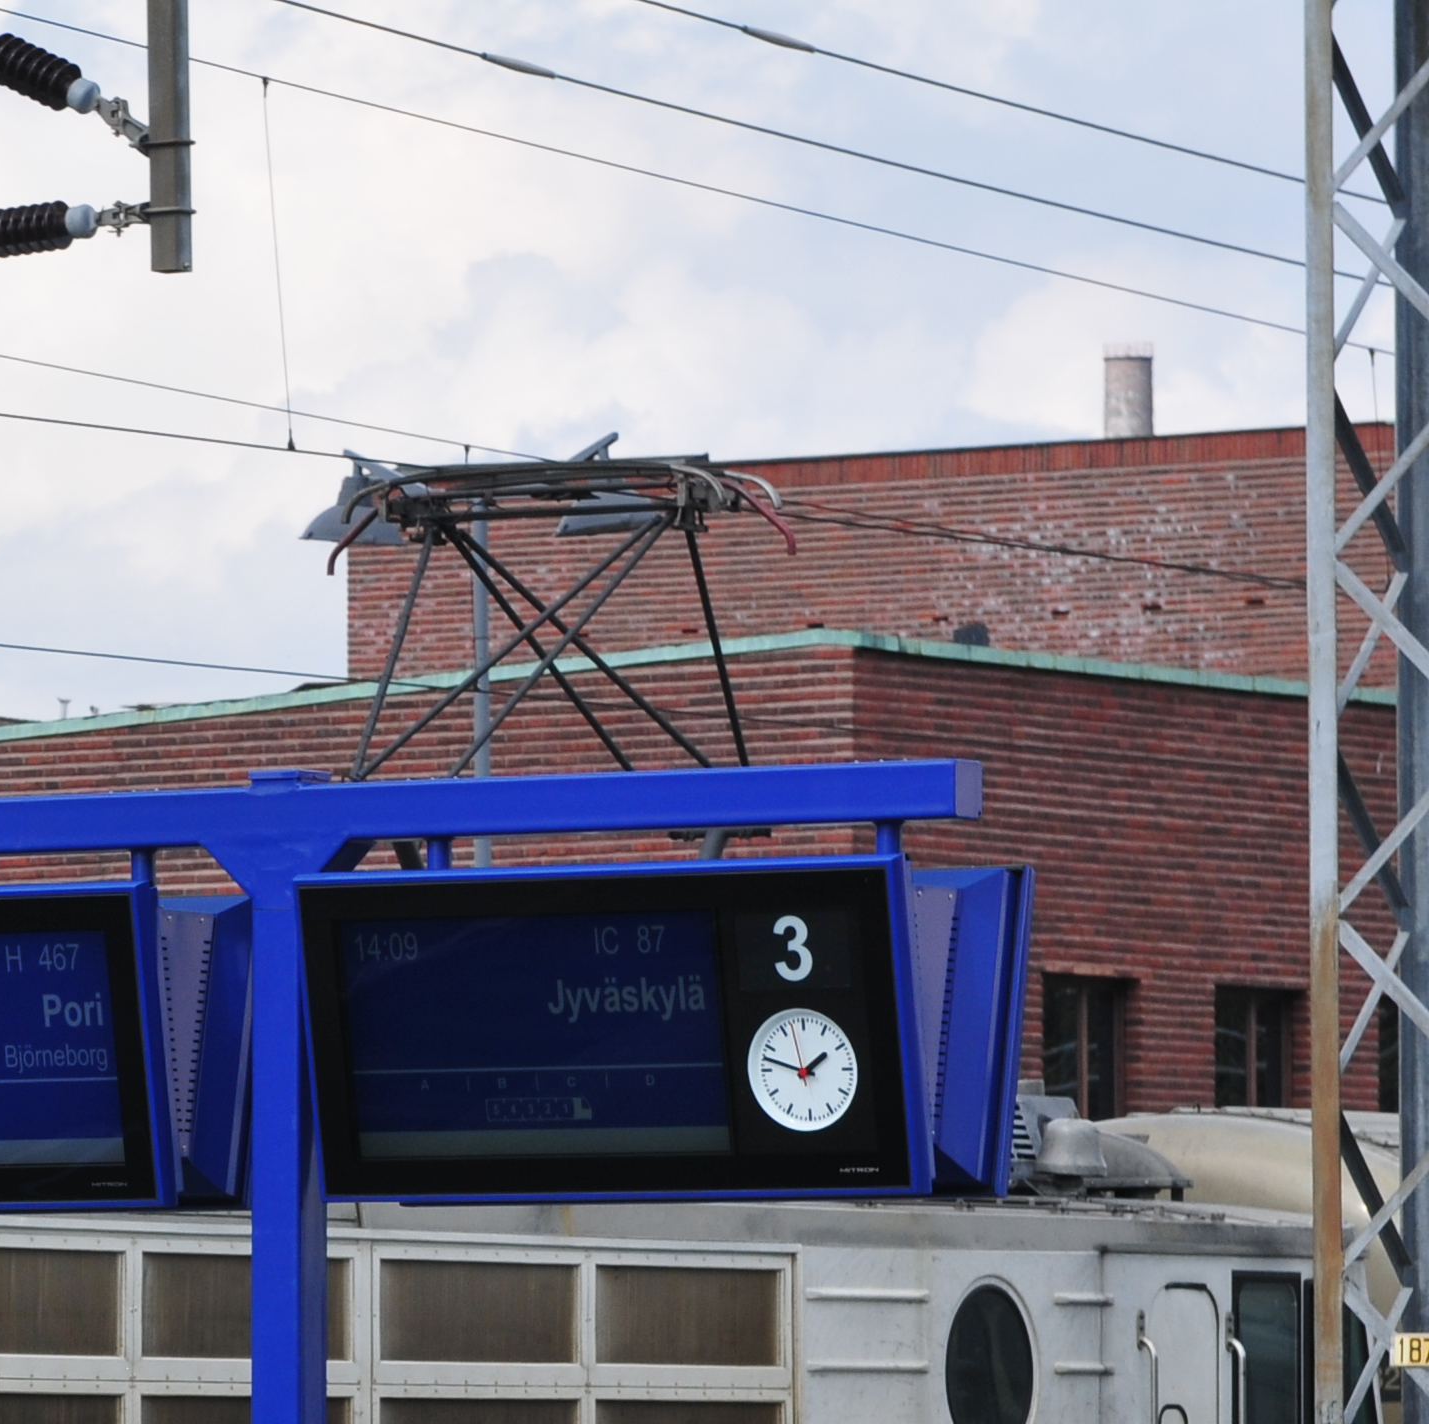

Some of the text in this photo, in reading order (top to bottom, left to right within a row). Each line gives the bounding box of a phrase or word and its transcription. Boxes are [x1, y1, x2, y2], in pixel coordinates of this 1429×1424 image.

[354, 932, 418, 961] 14:09
[593, 925, 665, 955] IC 87
[772, 915, 814, 982] 3
[5, 943, 80, 973] H 467
[42, 992, 104, 1028] Pori
[548, 974, 706, 1023] Jyväskylä
[4, 1043, 109, 1074] Björneborg
[567, 1076, 576, 1087] C
